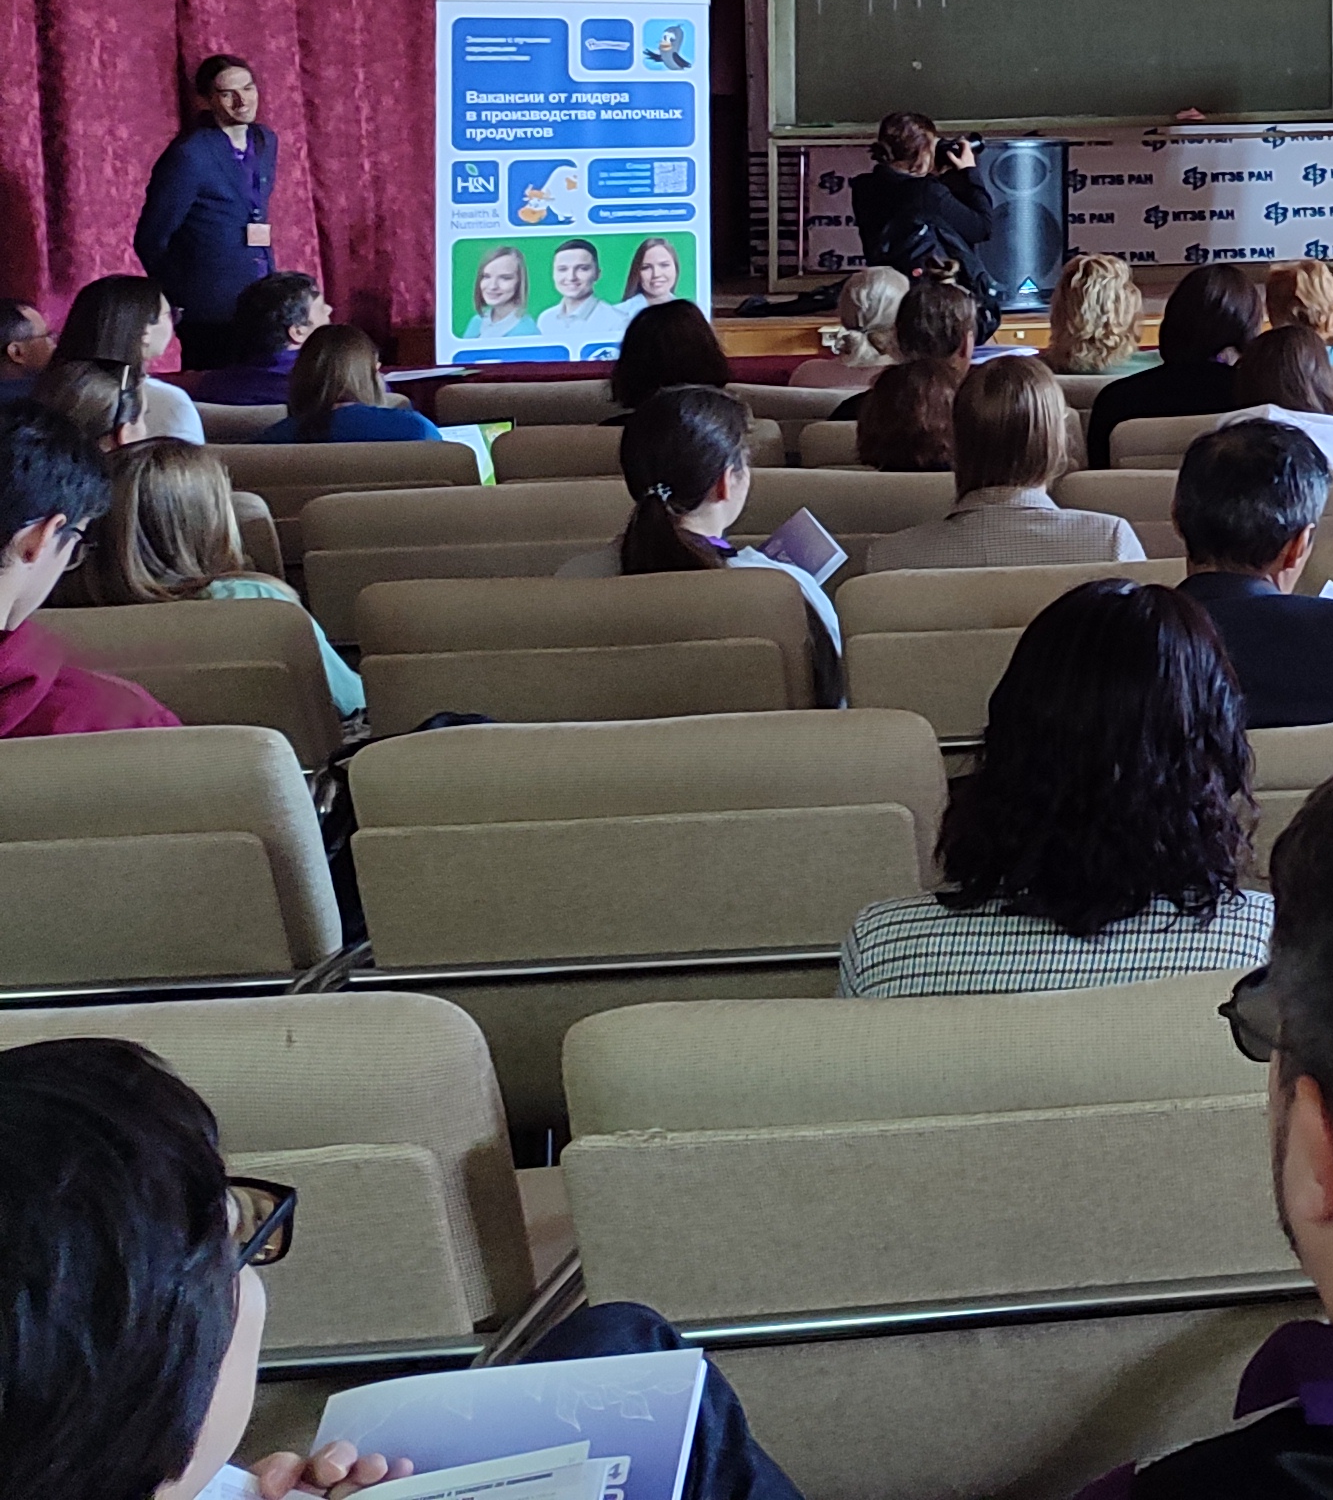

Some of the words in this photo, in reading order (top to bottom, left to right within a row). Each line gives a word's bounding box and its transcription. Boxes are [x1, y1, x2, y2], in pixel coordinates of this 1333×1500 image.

[465, 90, 545, 104] Вакансии
[548, 92, 568, 104] от
[570, 91, 630, 106] лидера
[466, 111, 477, 121] в
[481, 109, 597, 124] производстве
[600, 108, 683, 120] молочных
[465, 126, 554, 142] продуктов
[1090, 174, 1125, 186] ИТЭБ
[1127, 173, 1154, 185] РАН
[1210, 171, 1245, 183] ИТЭБ
[1247, 170, 1274, 182] РАН
[457, 175, 495, 193] H&N
[451, 209, 490, 219] Health
[491, 208, 500, 218] &
[1068, 212, 1087, 224] ЭБ
[1089, 212, 1115, 224] РАН
[1171, 210, 1207, 222] ИТЭБ
[1209, 209, 1236, 221] РАН
[1292, 206, 1326, 219] ИТЭБ
[450, 220, 501, 230] Nutrition
[1129, 250, 1156, 263] РАН
[1212, 247, 1248, 260] ИТЭБ
[1250, 246, 1276, 260] РАН
